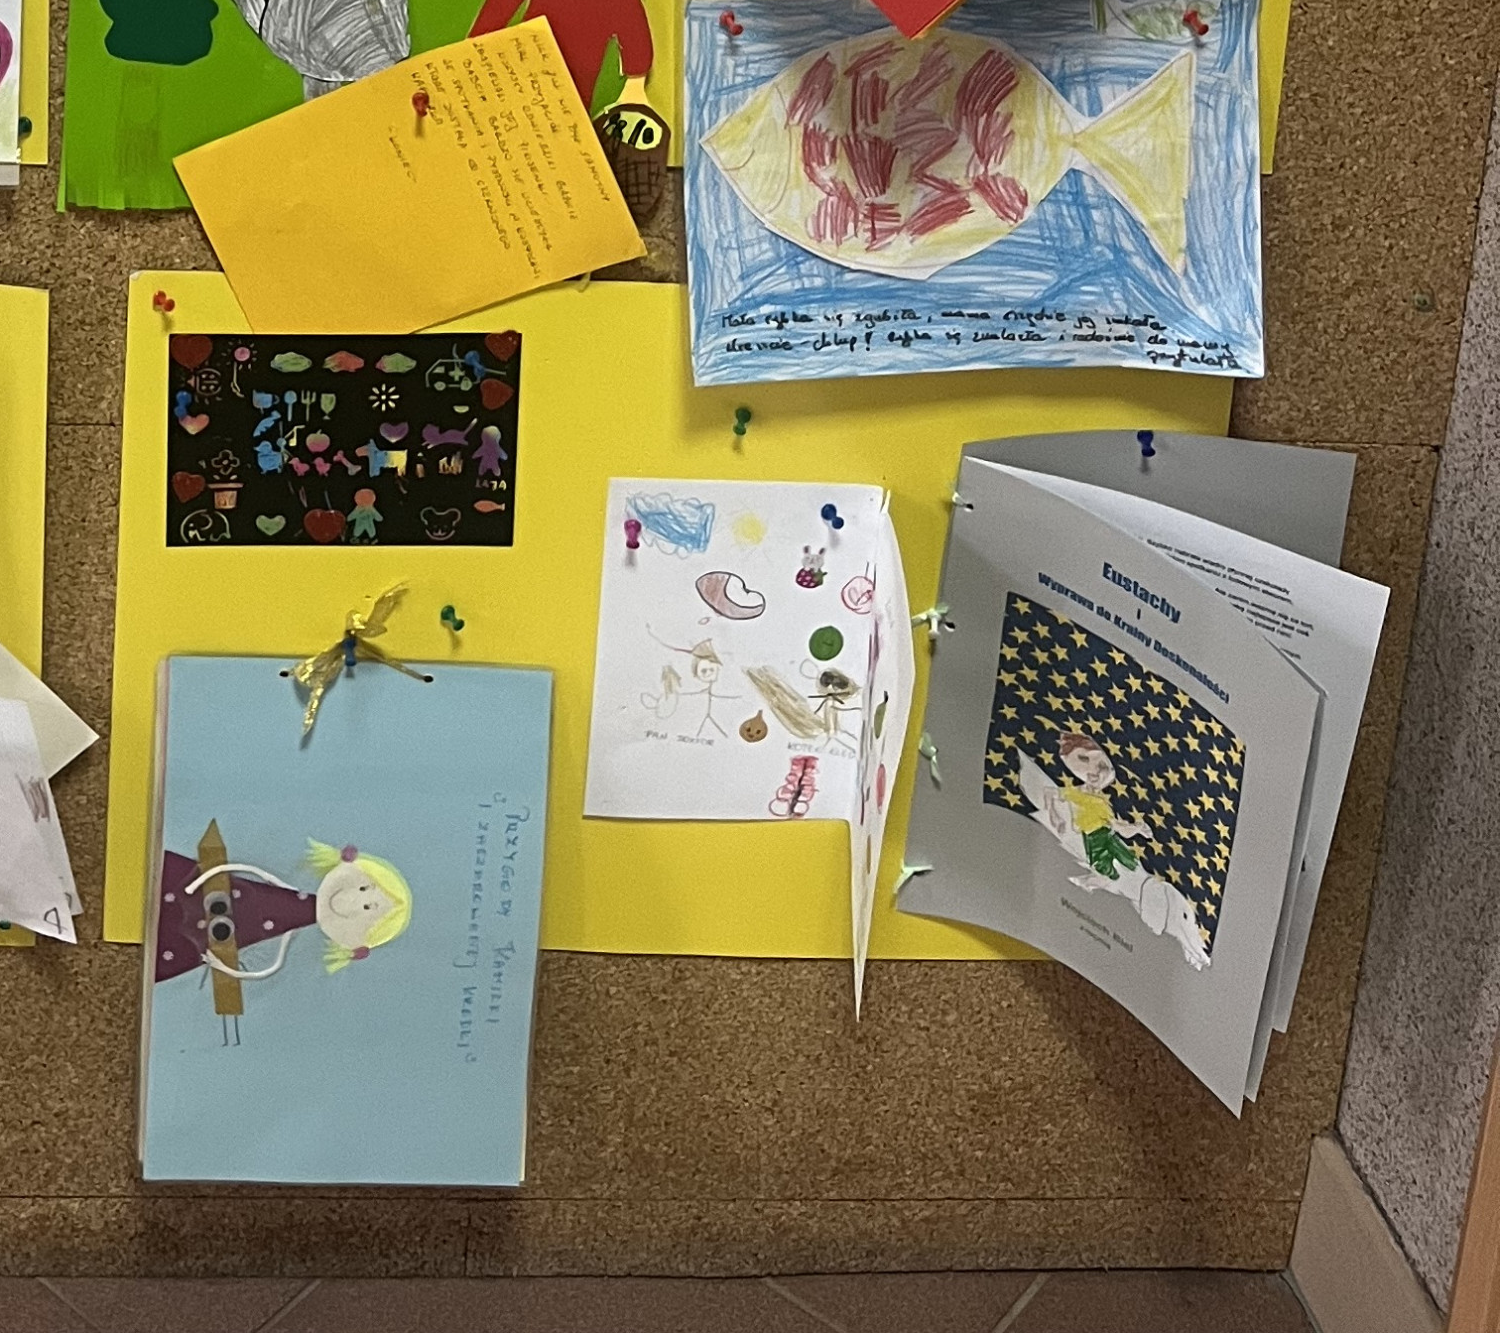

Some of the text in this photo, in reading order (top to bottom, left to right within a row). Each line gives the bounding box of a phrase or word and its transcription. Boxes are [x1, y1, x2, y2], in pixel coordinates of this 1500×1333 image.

[1038, 572, 1094, 611] Wyprawa
[1096, 606, 1111, 621] do
[1114, 614, 1152, 647] Krainy
[1103, 561, 1181, 623] Eustachy
